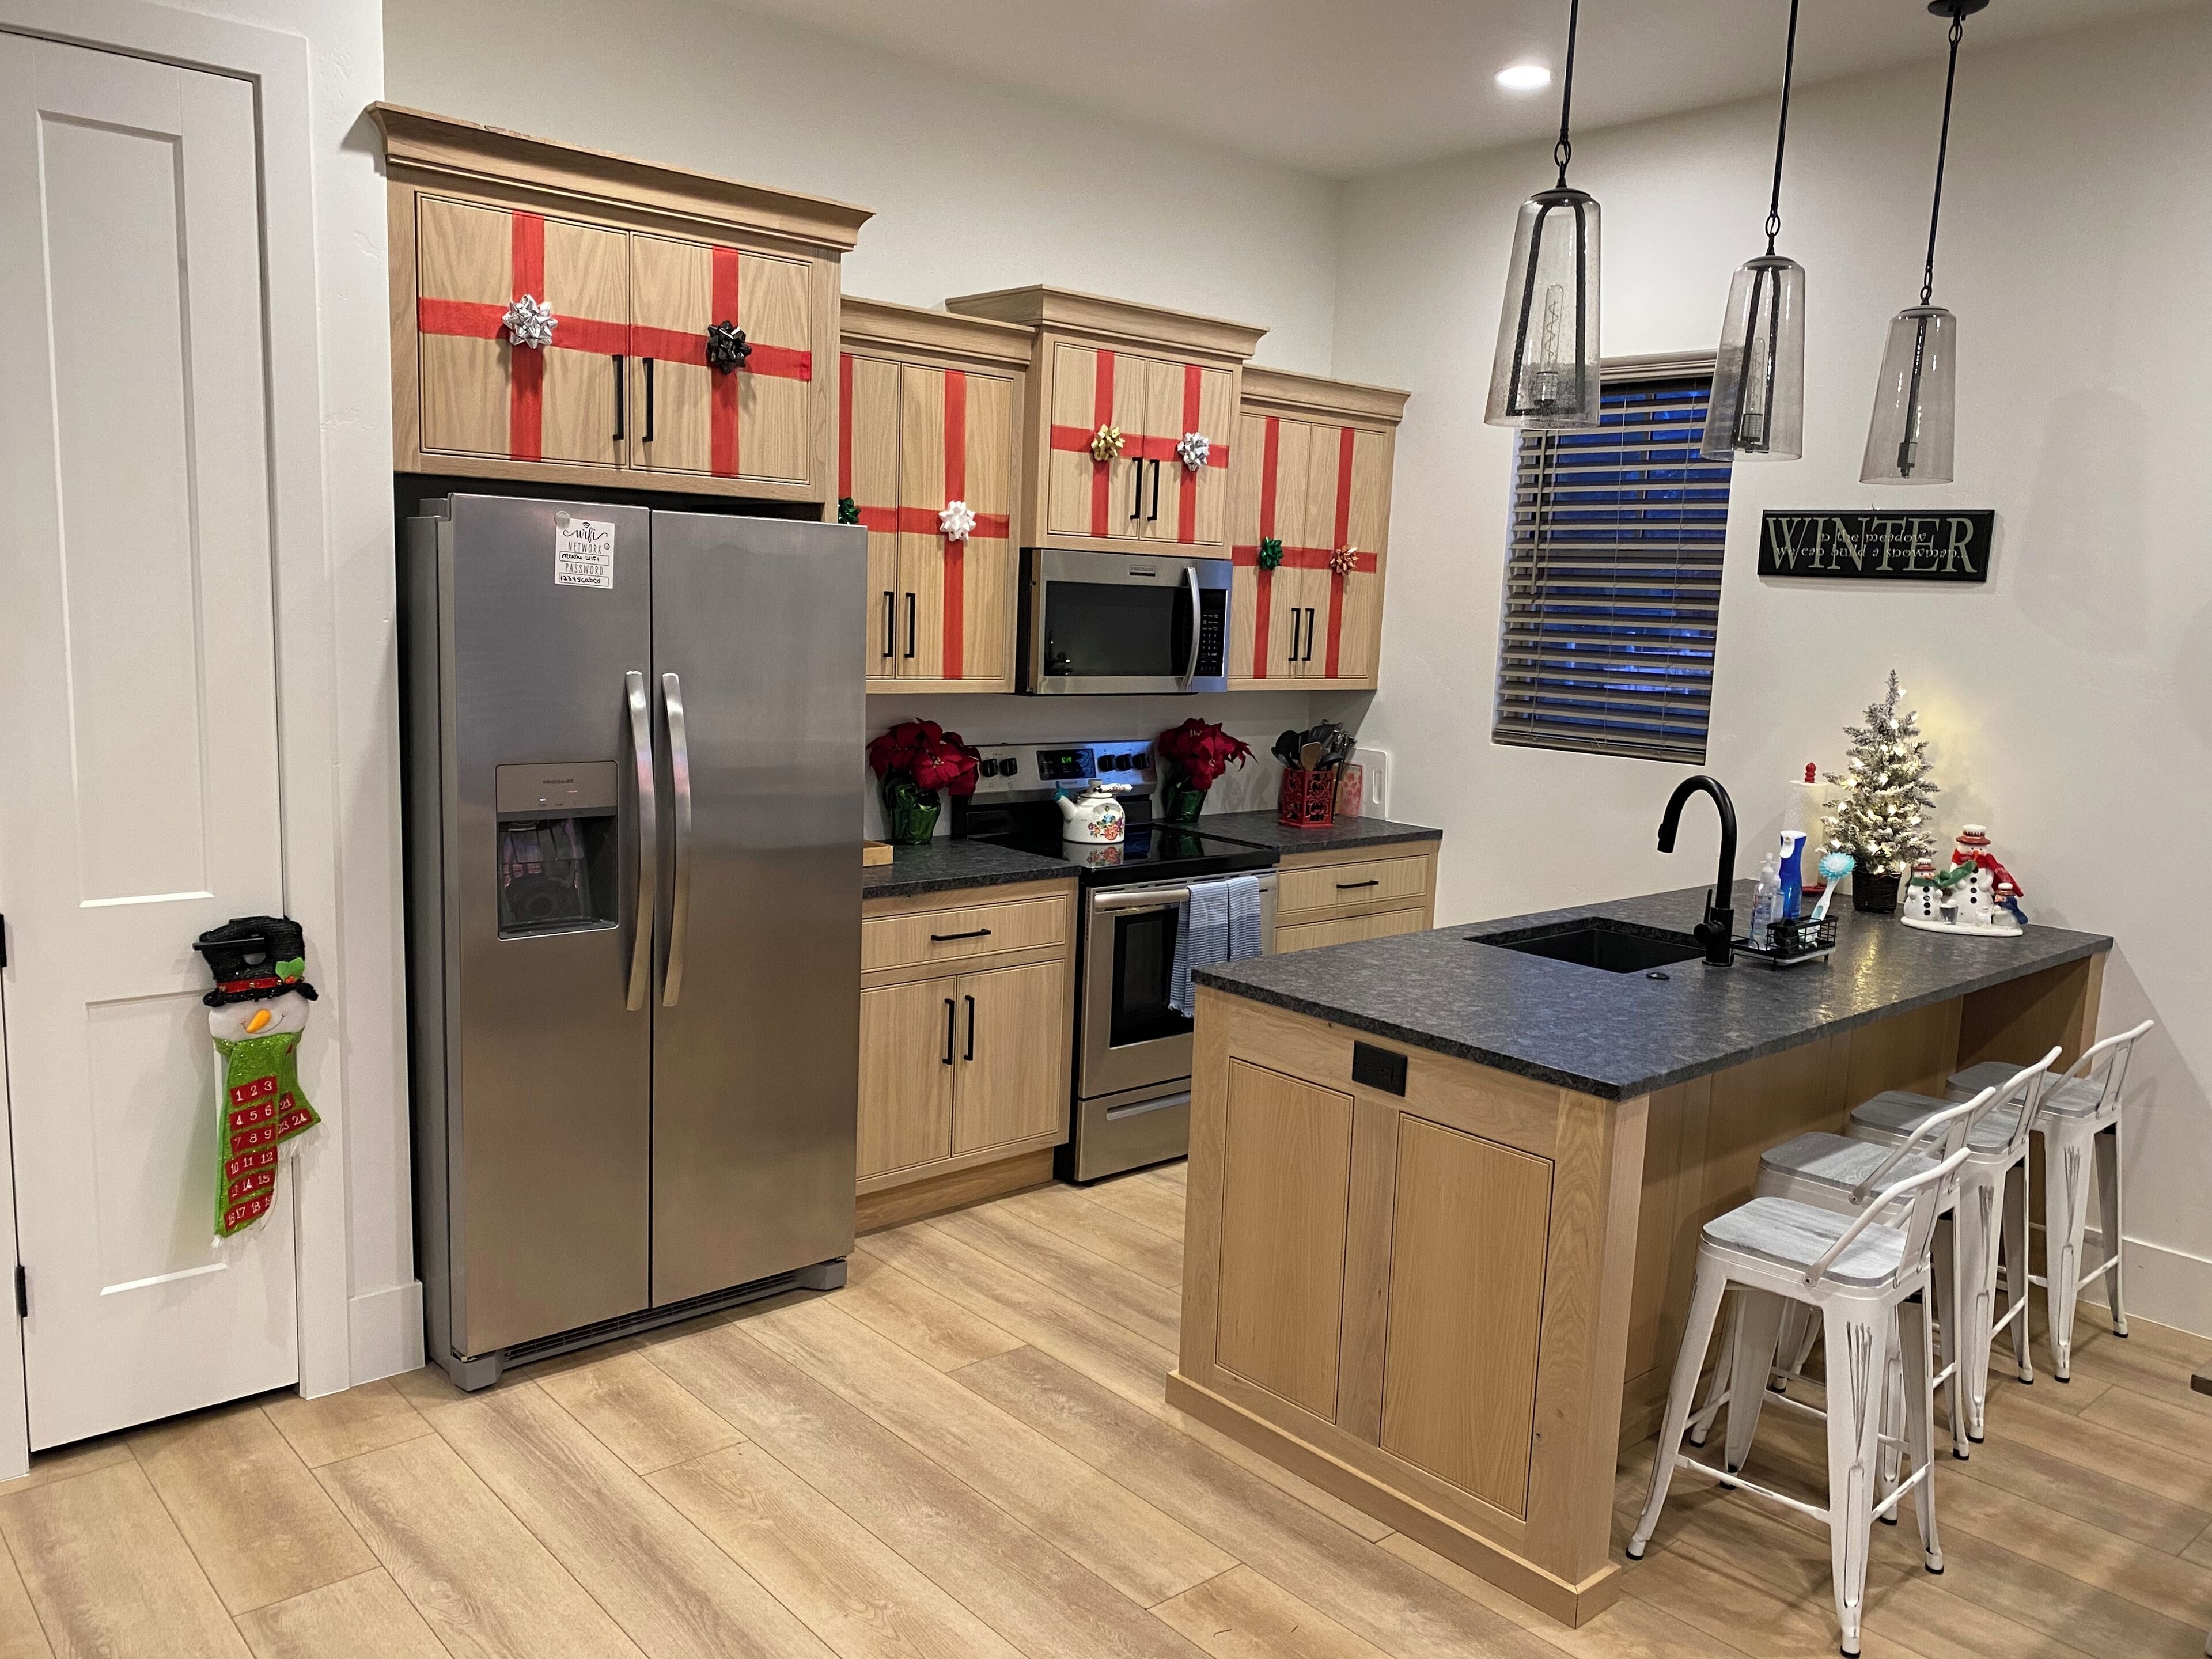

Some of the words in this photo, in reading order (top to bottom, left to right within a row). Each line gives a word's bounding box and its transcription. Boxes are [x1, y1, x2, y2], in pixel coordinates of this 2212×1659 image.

[563, 527, 608, 543] wifi
[1866, 530, 1926, 543] meadow
[568, 541, 601, 554] NETWORK
[1766, 516, 1977, 573] WINTER
[565, 563, 603, 575] PASSWORD
[236, 1090, 244, 1101] 1
[250, 1085, 257, 1096] 2
[264, 1081, 272, 1091] 3
[279, 1099, 292, 1110] 21
[236, 1115, 244, 1126] 4
[249, 1111, 257, 1120] 5
[264, 1105, 271, 1116] 6
[292, 1113, 307, 1126] 24
[234, 1137, 241, 1148] 7
[249, 1134, 257, 1143] 8
[264, 1130, 272, 1139] 9
[231, 1162, 239, 1175] 10
[243, 1157, 253, 1168] 11
[260, 1152, 274, 1164] 12
[243, 1178, 253, 1191] 14
[258, 1175, 270, 1185] 15
[236, 1206, 246, 1219] 17
[251, 1202, 260, 1213] 18
